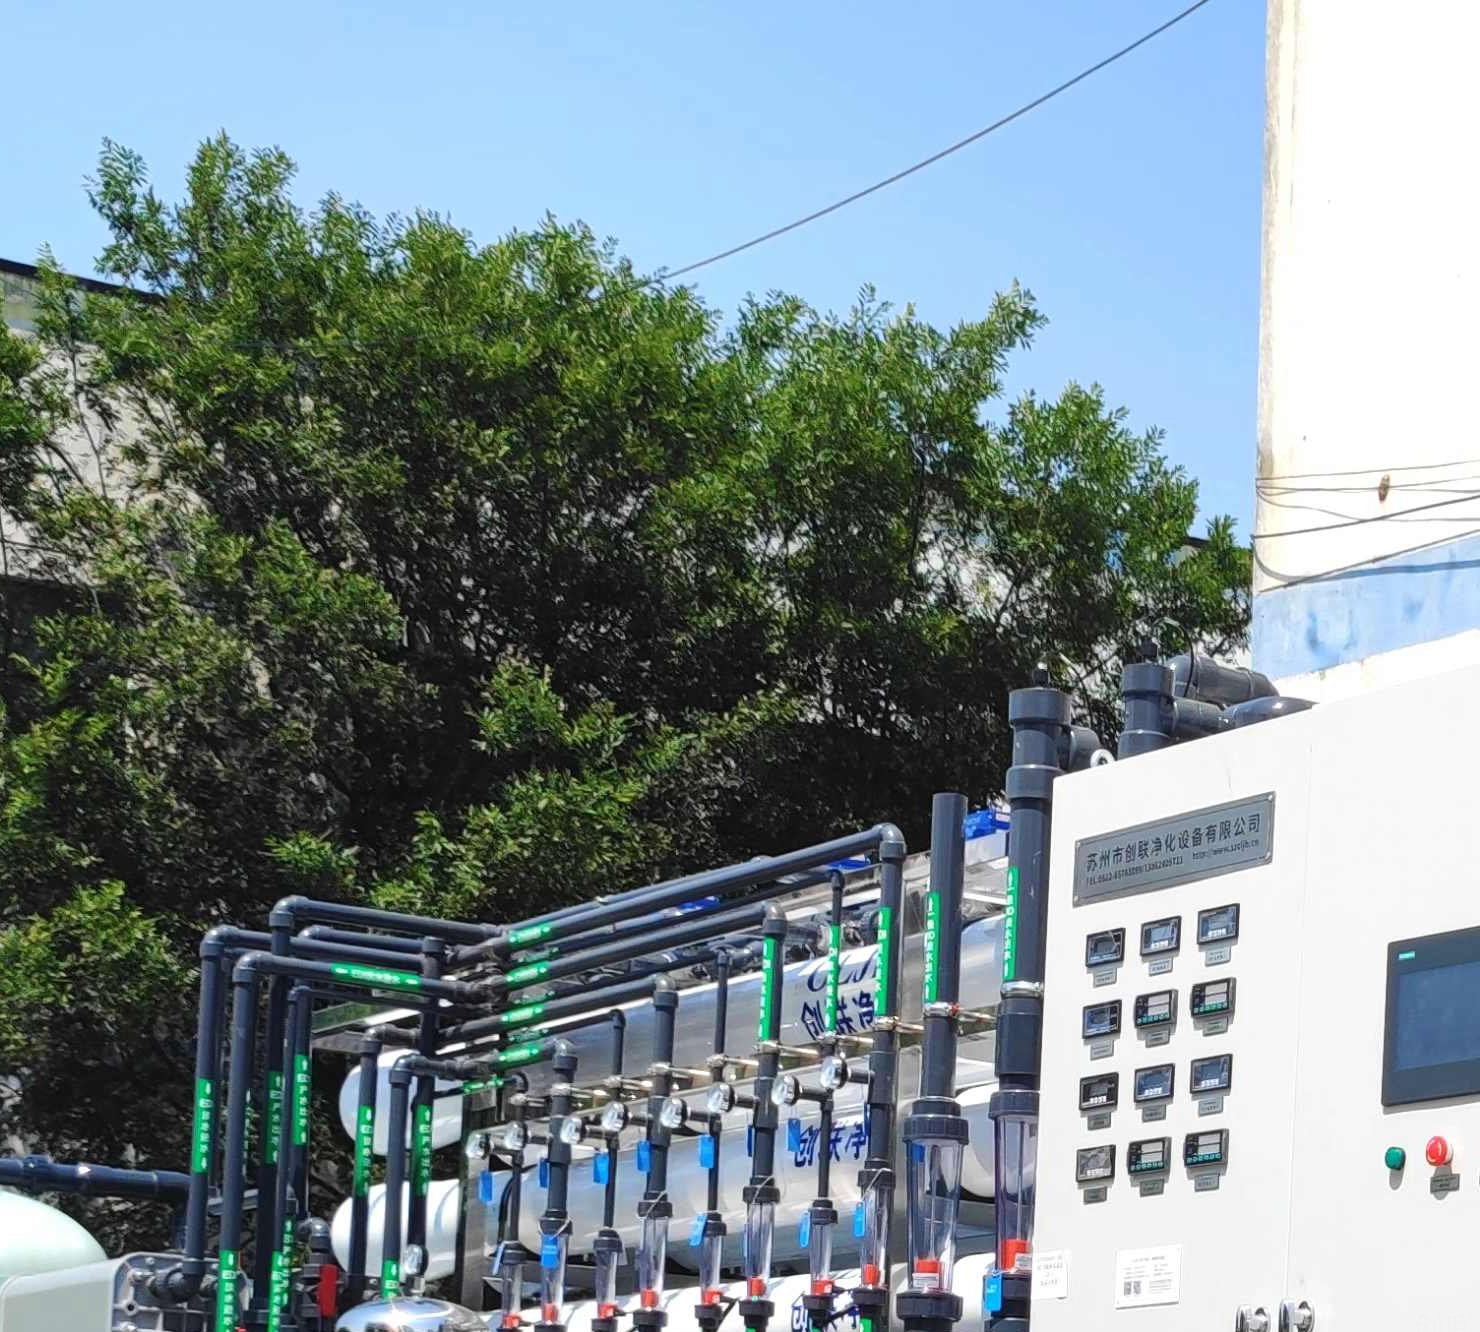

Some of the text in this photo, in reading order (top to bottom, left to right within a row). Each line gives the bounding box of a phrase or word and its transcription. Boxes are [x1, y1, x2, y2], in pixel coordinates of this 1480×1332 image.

[1086, 813, 1260, 872] 苏州市创联净化设备有限公司
